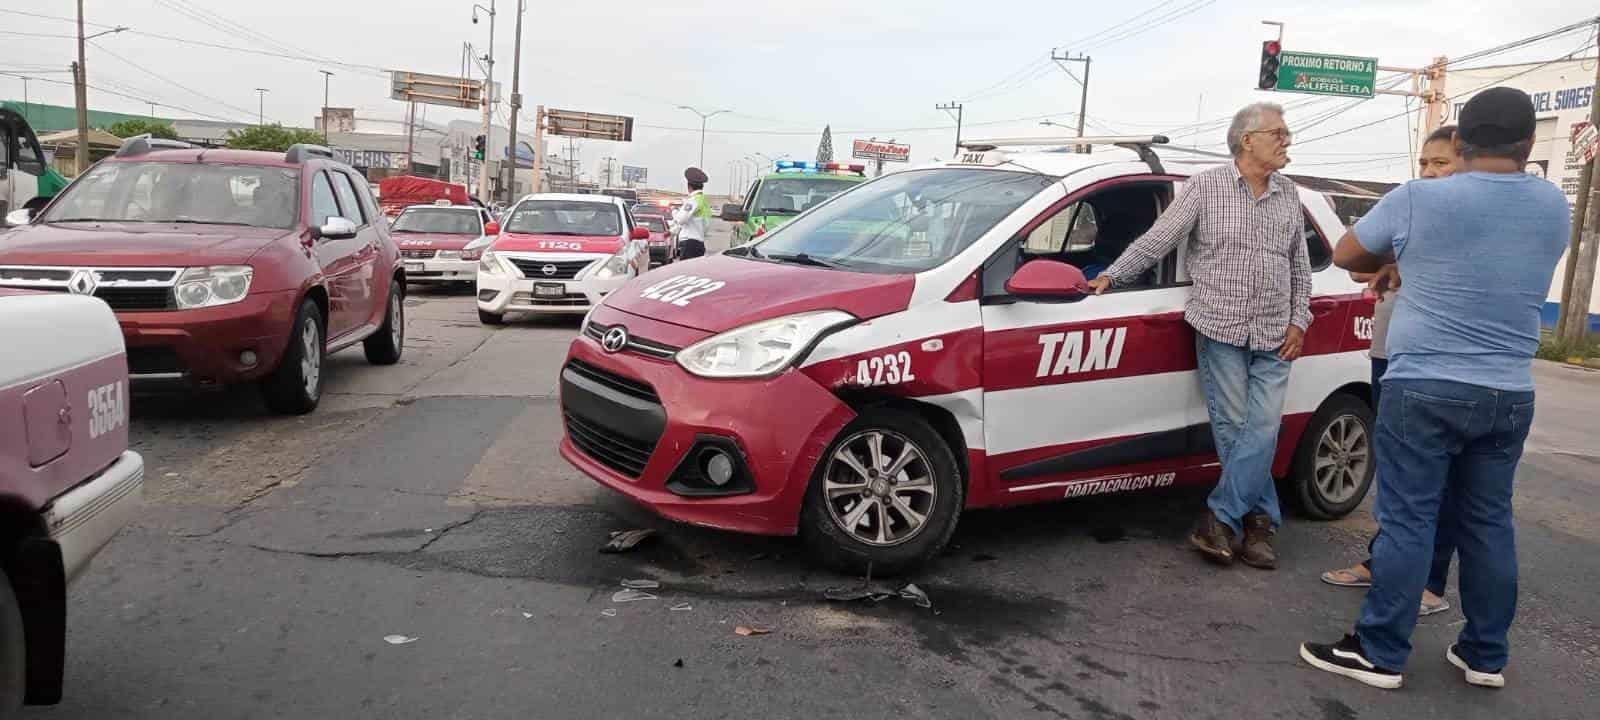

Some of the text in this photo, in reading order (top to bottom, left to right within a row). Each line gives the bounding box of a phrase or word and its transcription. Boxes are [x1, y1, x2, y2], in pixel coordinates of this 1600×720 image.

[1282, 55, 1373, 73] PROXIMO RETORNO A
[1294, 81, 1371, 94] AURRERA
[1534, 90, 1552, 112] DEL
[960, 153, 985, 163] TAXI
[537, 240, 582, 249] 1126
[640, 274, 726, 306] 4232
[1353, 316, 1375, 340] 423
[1035, 326, 1128, 378] TAXI
[856, 351, 915, 388] 4232
[87, 380, 125, 439] 3554
[1064, 472, 1176, 498] COATZACOALCOS VER
